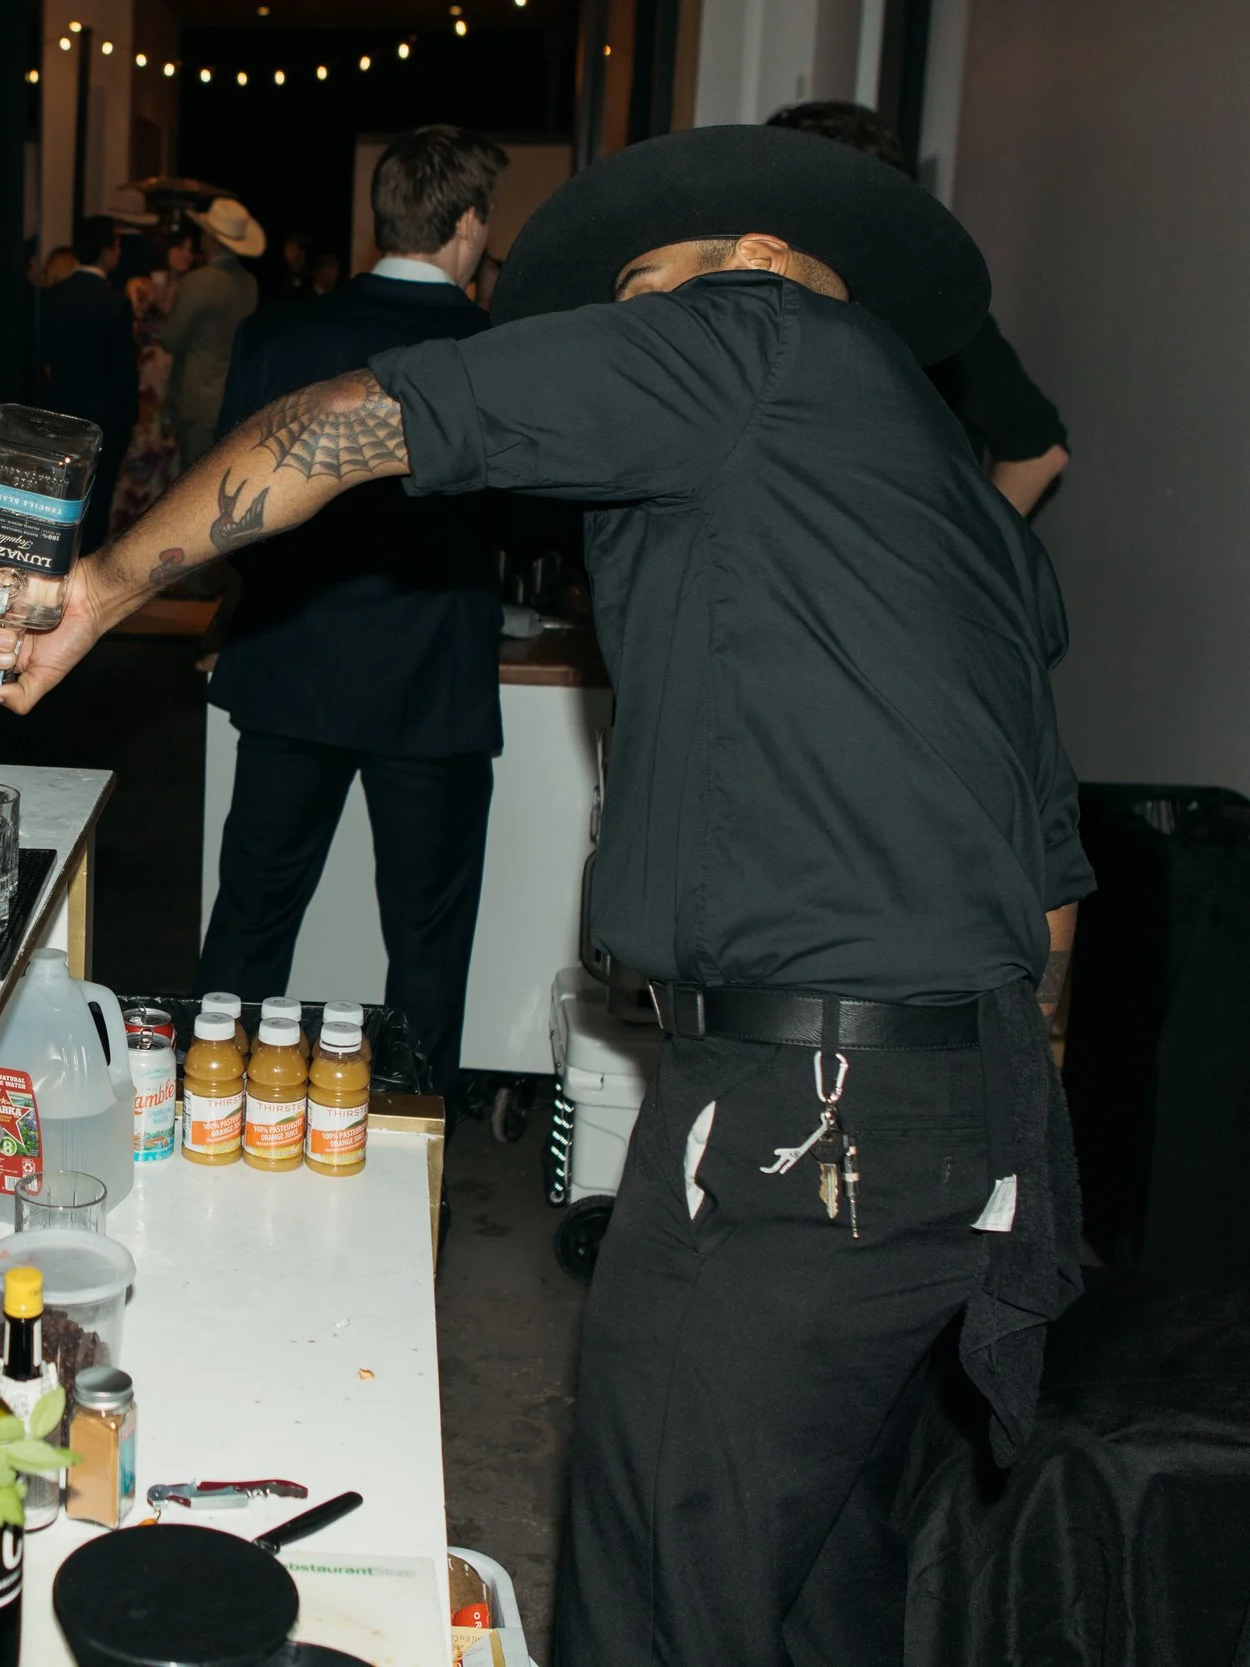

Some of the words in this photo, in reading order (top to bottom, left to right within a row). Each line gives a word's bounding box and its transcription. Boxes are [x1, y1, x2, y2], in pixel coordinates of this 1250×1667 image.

[23, 500, 62, 515] TEQUILA
[42, 533, 60, 542] 100%
[5, 1081, 26, 1090] WATER
[134, 1078, 176, 1112] amble
[254, 1125, 269, 1134] 100%
[261, 1133, 285, 1142] ORANGE
[285, 1130, 299, 1139] JUICE
[330, 1138, 355, 1148] ORANGE
